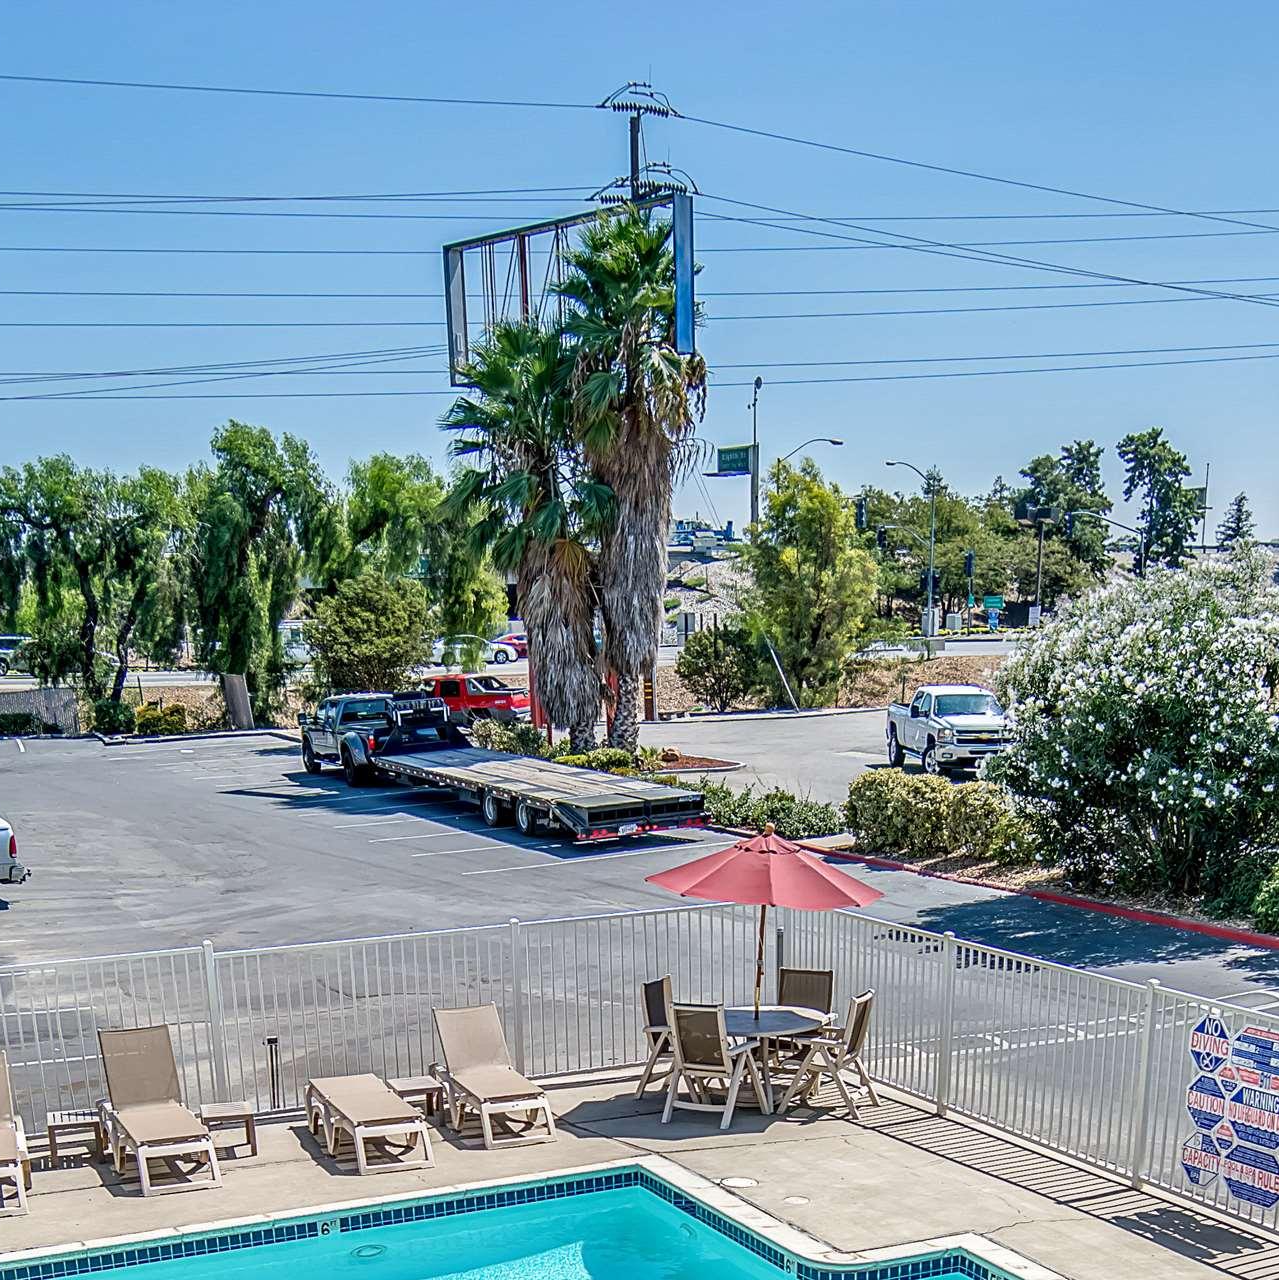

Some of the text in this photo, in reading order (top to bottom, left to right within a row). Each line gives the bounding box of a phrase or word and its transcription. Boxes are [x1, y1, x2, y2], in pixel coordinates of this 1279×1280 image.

[1204, 1018, 1221, 1037] NO
[1191, 1033, 1229, 1056] DIVING
[1187, 1090, 1225, 1116] CAUTION
[1242, 1087, 1279, 1113] WARNING
[1228, 1103, 1237, 1119] NO
[1237, 1106, 1265, 1126] LIFEGUARD
[1267, 1113, 1276, 1130] ON
[1182, 1147, 1221, 1174] CAPACITY
[1202, 1143, 1217, 1155] POOL
[1224, 1160, 1240, 1174] POOL
[1245, 1166, 1256, 1177] SPA
[321, 1222, 330, 1236] 6
